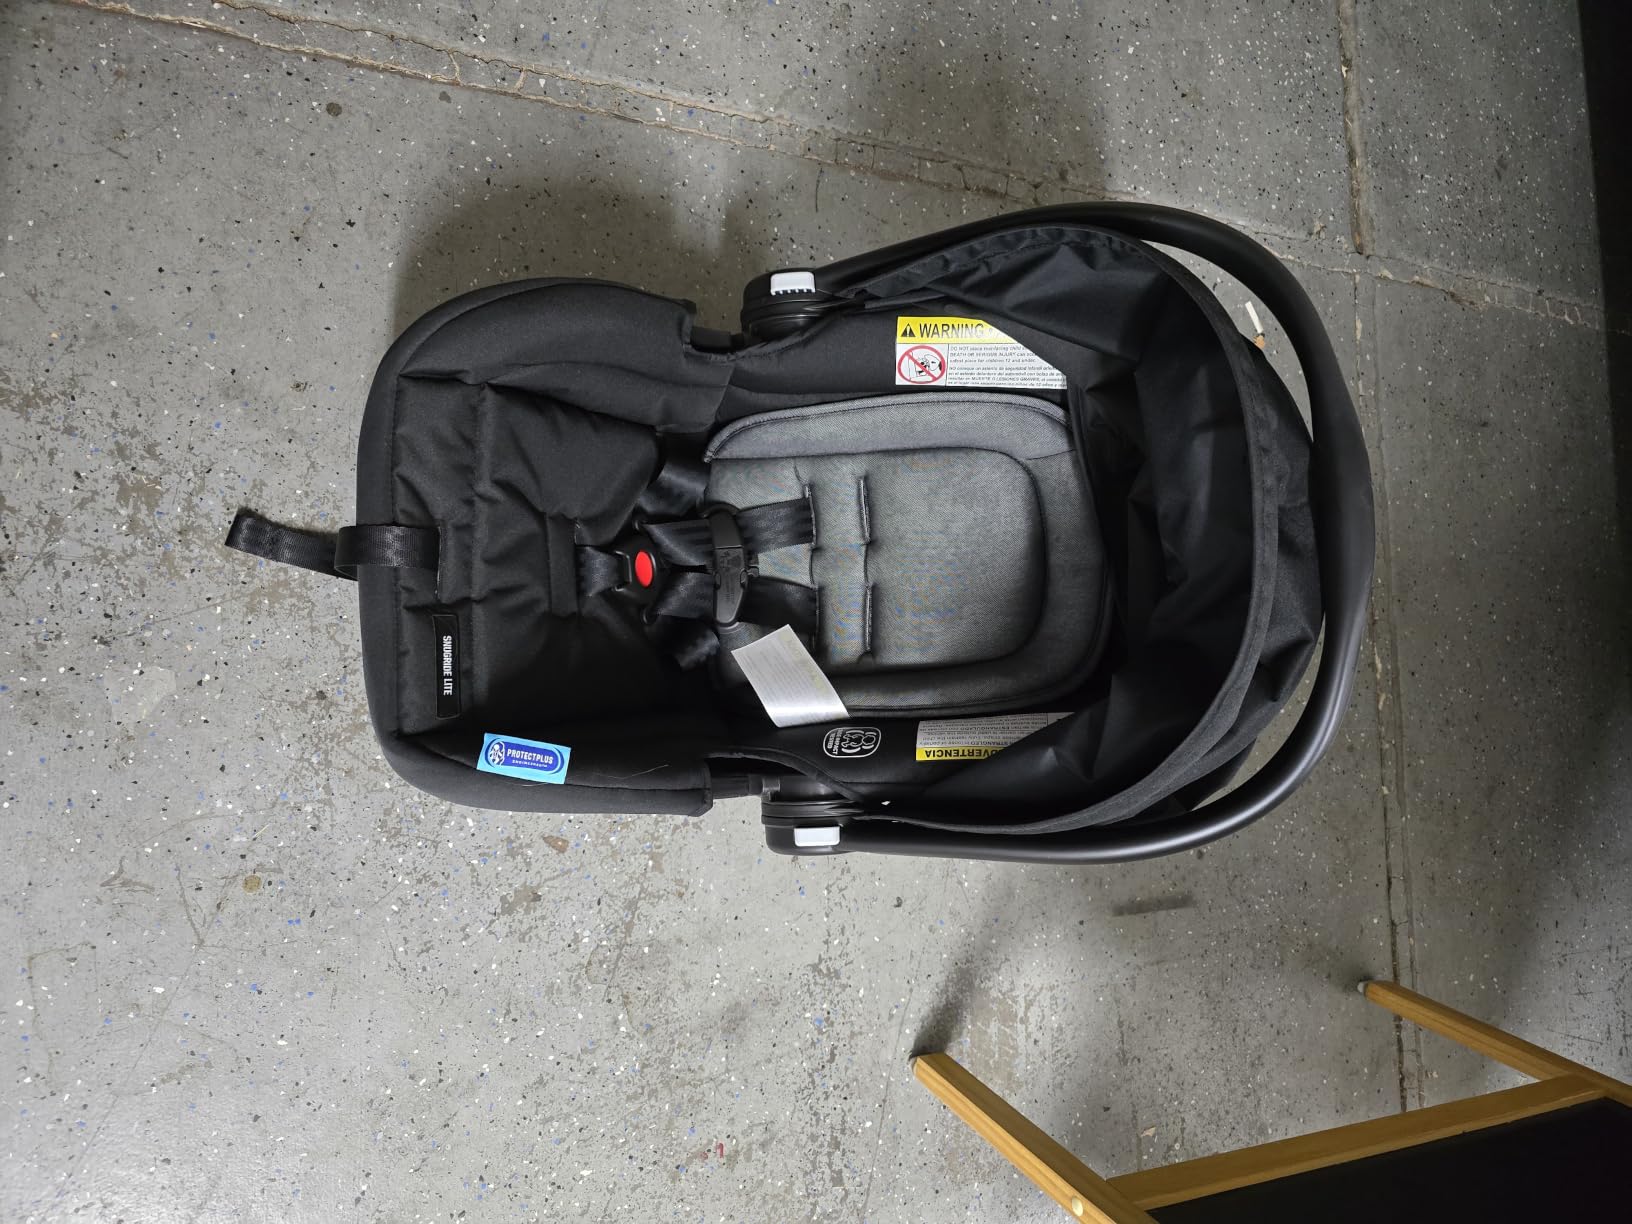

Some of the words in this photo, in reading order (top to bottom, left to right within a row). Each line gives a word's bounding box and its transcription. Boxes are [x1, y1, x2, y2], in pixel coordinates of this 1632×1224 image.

[920, 323, 984, 338] WARNING
[443, 636, 452, 676] SNUGRIDE
[444, 678, 452, 696] LITE
[507, 748, 553, 764] PROTECTPLUS
[925, 748, 997, 758] DVERTENCIA
